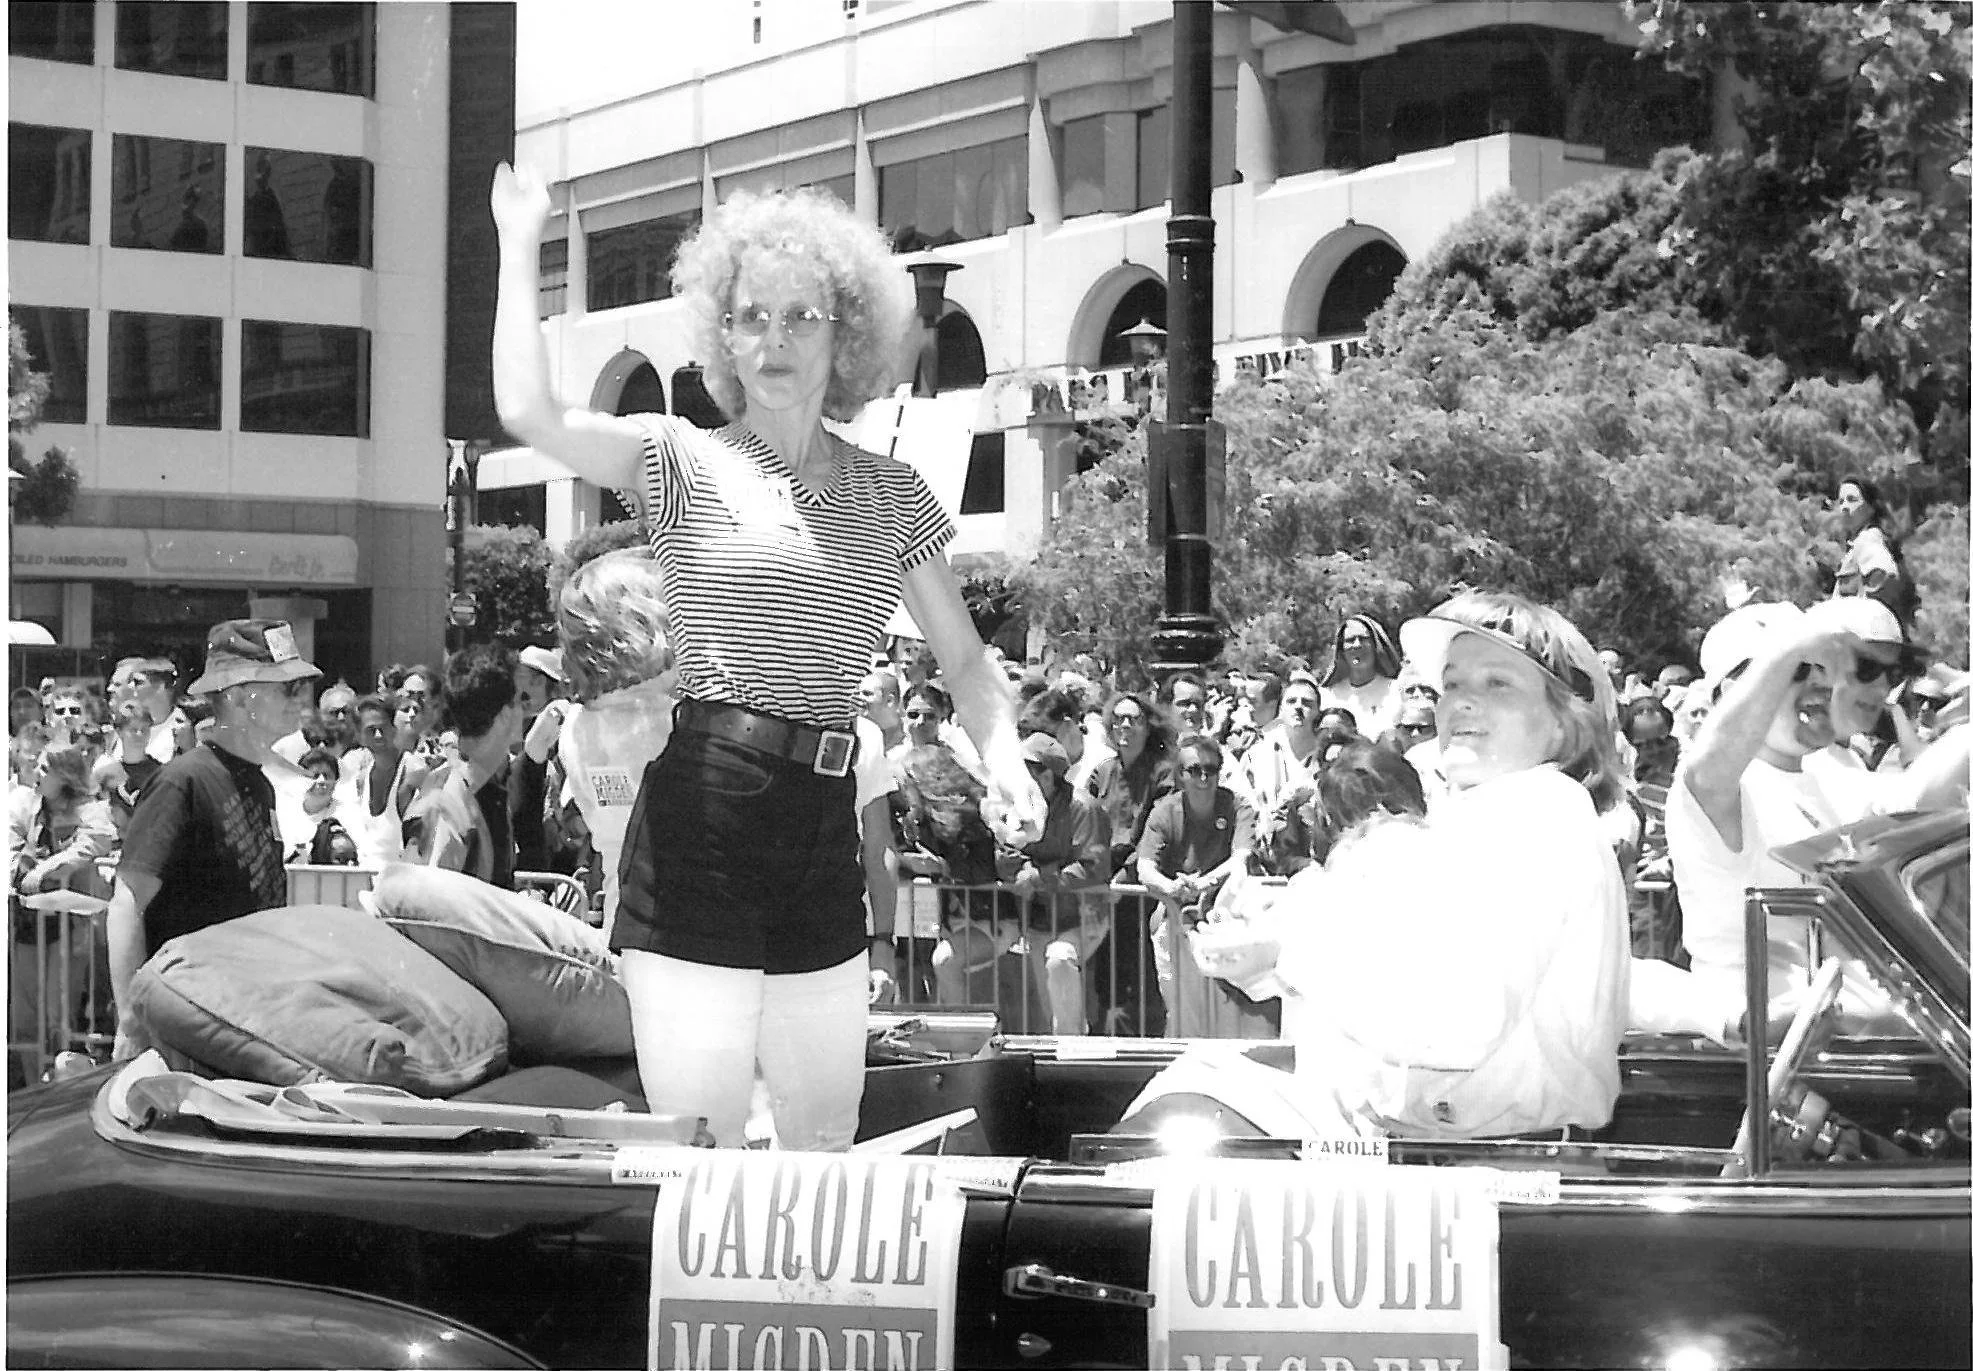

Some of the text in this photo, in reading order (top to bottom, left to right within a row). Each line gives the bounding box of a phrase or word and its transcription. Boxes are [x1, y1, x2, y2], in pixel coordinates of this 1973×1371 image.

[47, 555, 129, 568] HAMBURGERS
[1305, 1140, 1384, 1157] AROLE
[678, 1159, 936, 1286] CAROLE
[1184, 1181, 1462, 1310] CAROLE
